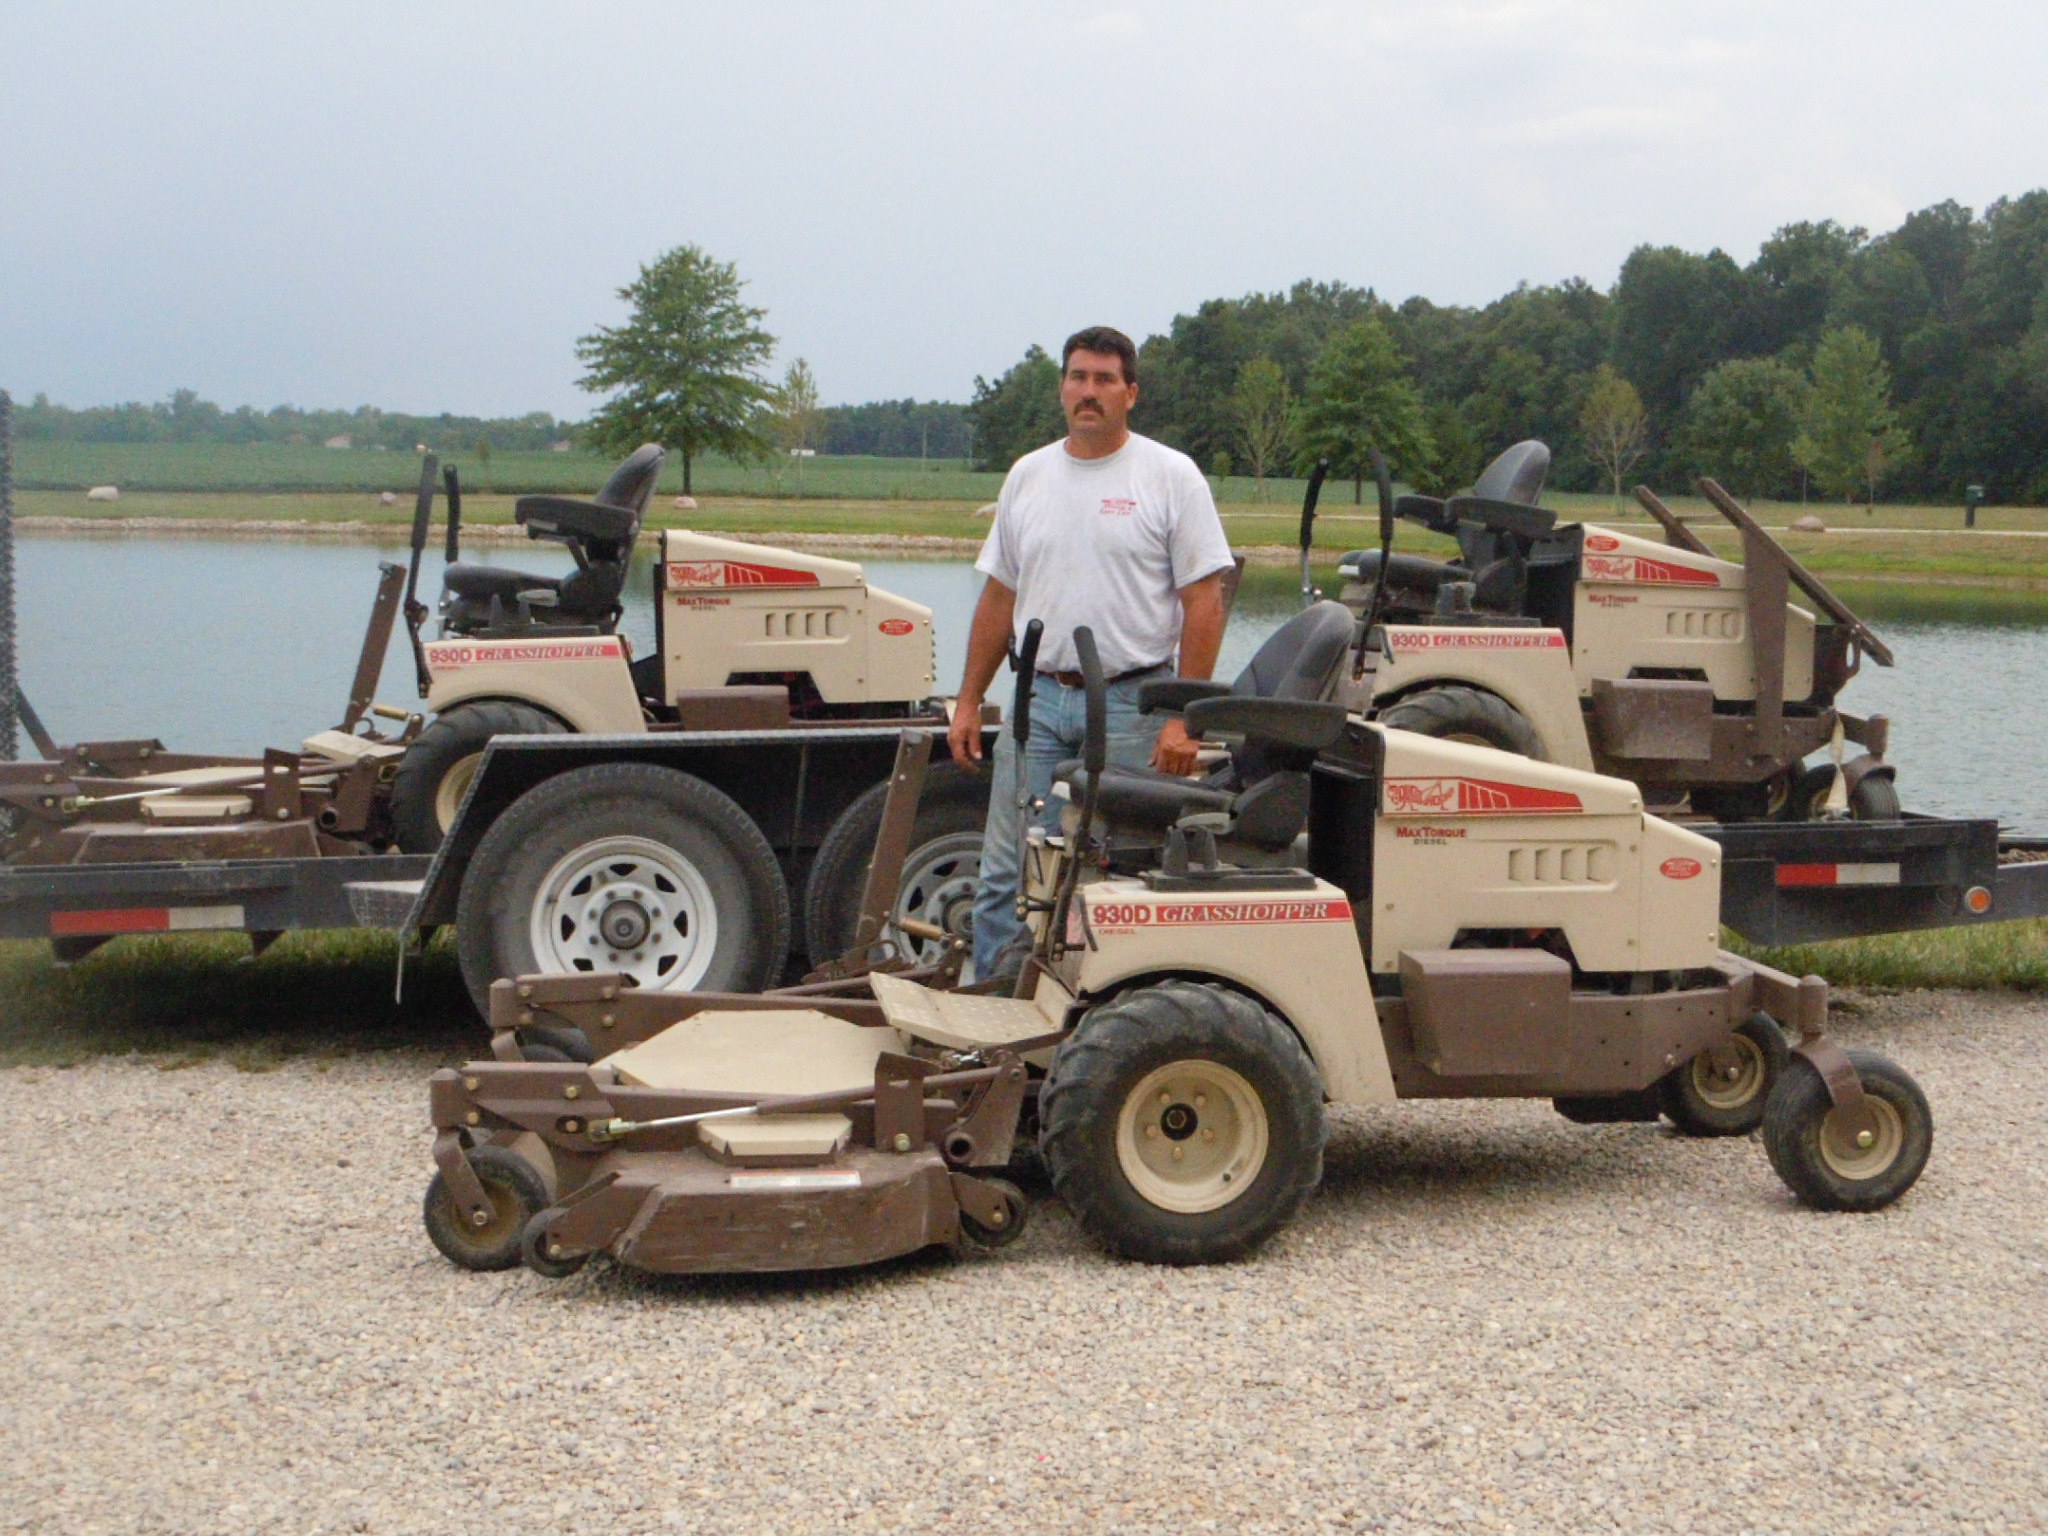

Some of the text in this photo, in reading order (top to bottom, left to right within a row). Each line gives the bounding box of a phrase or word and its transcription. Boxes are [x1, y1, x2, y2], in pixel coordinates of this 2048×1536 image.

[430, 645, 603, 663] 930D GRASSHOPPER
[1093, 902, 1328, 924] 930D GRASSHOPPER
